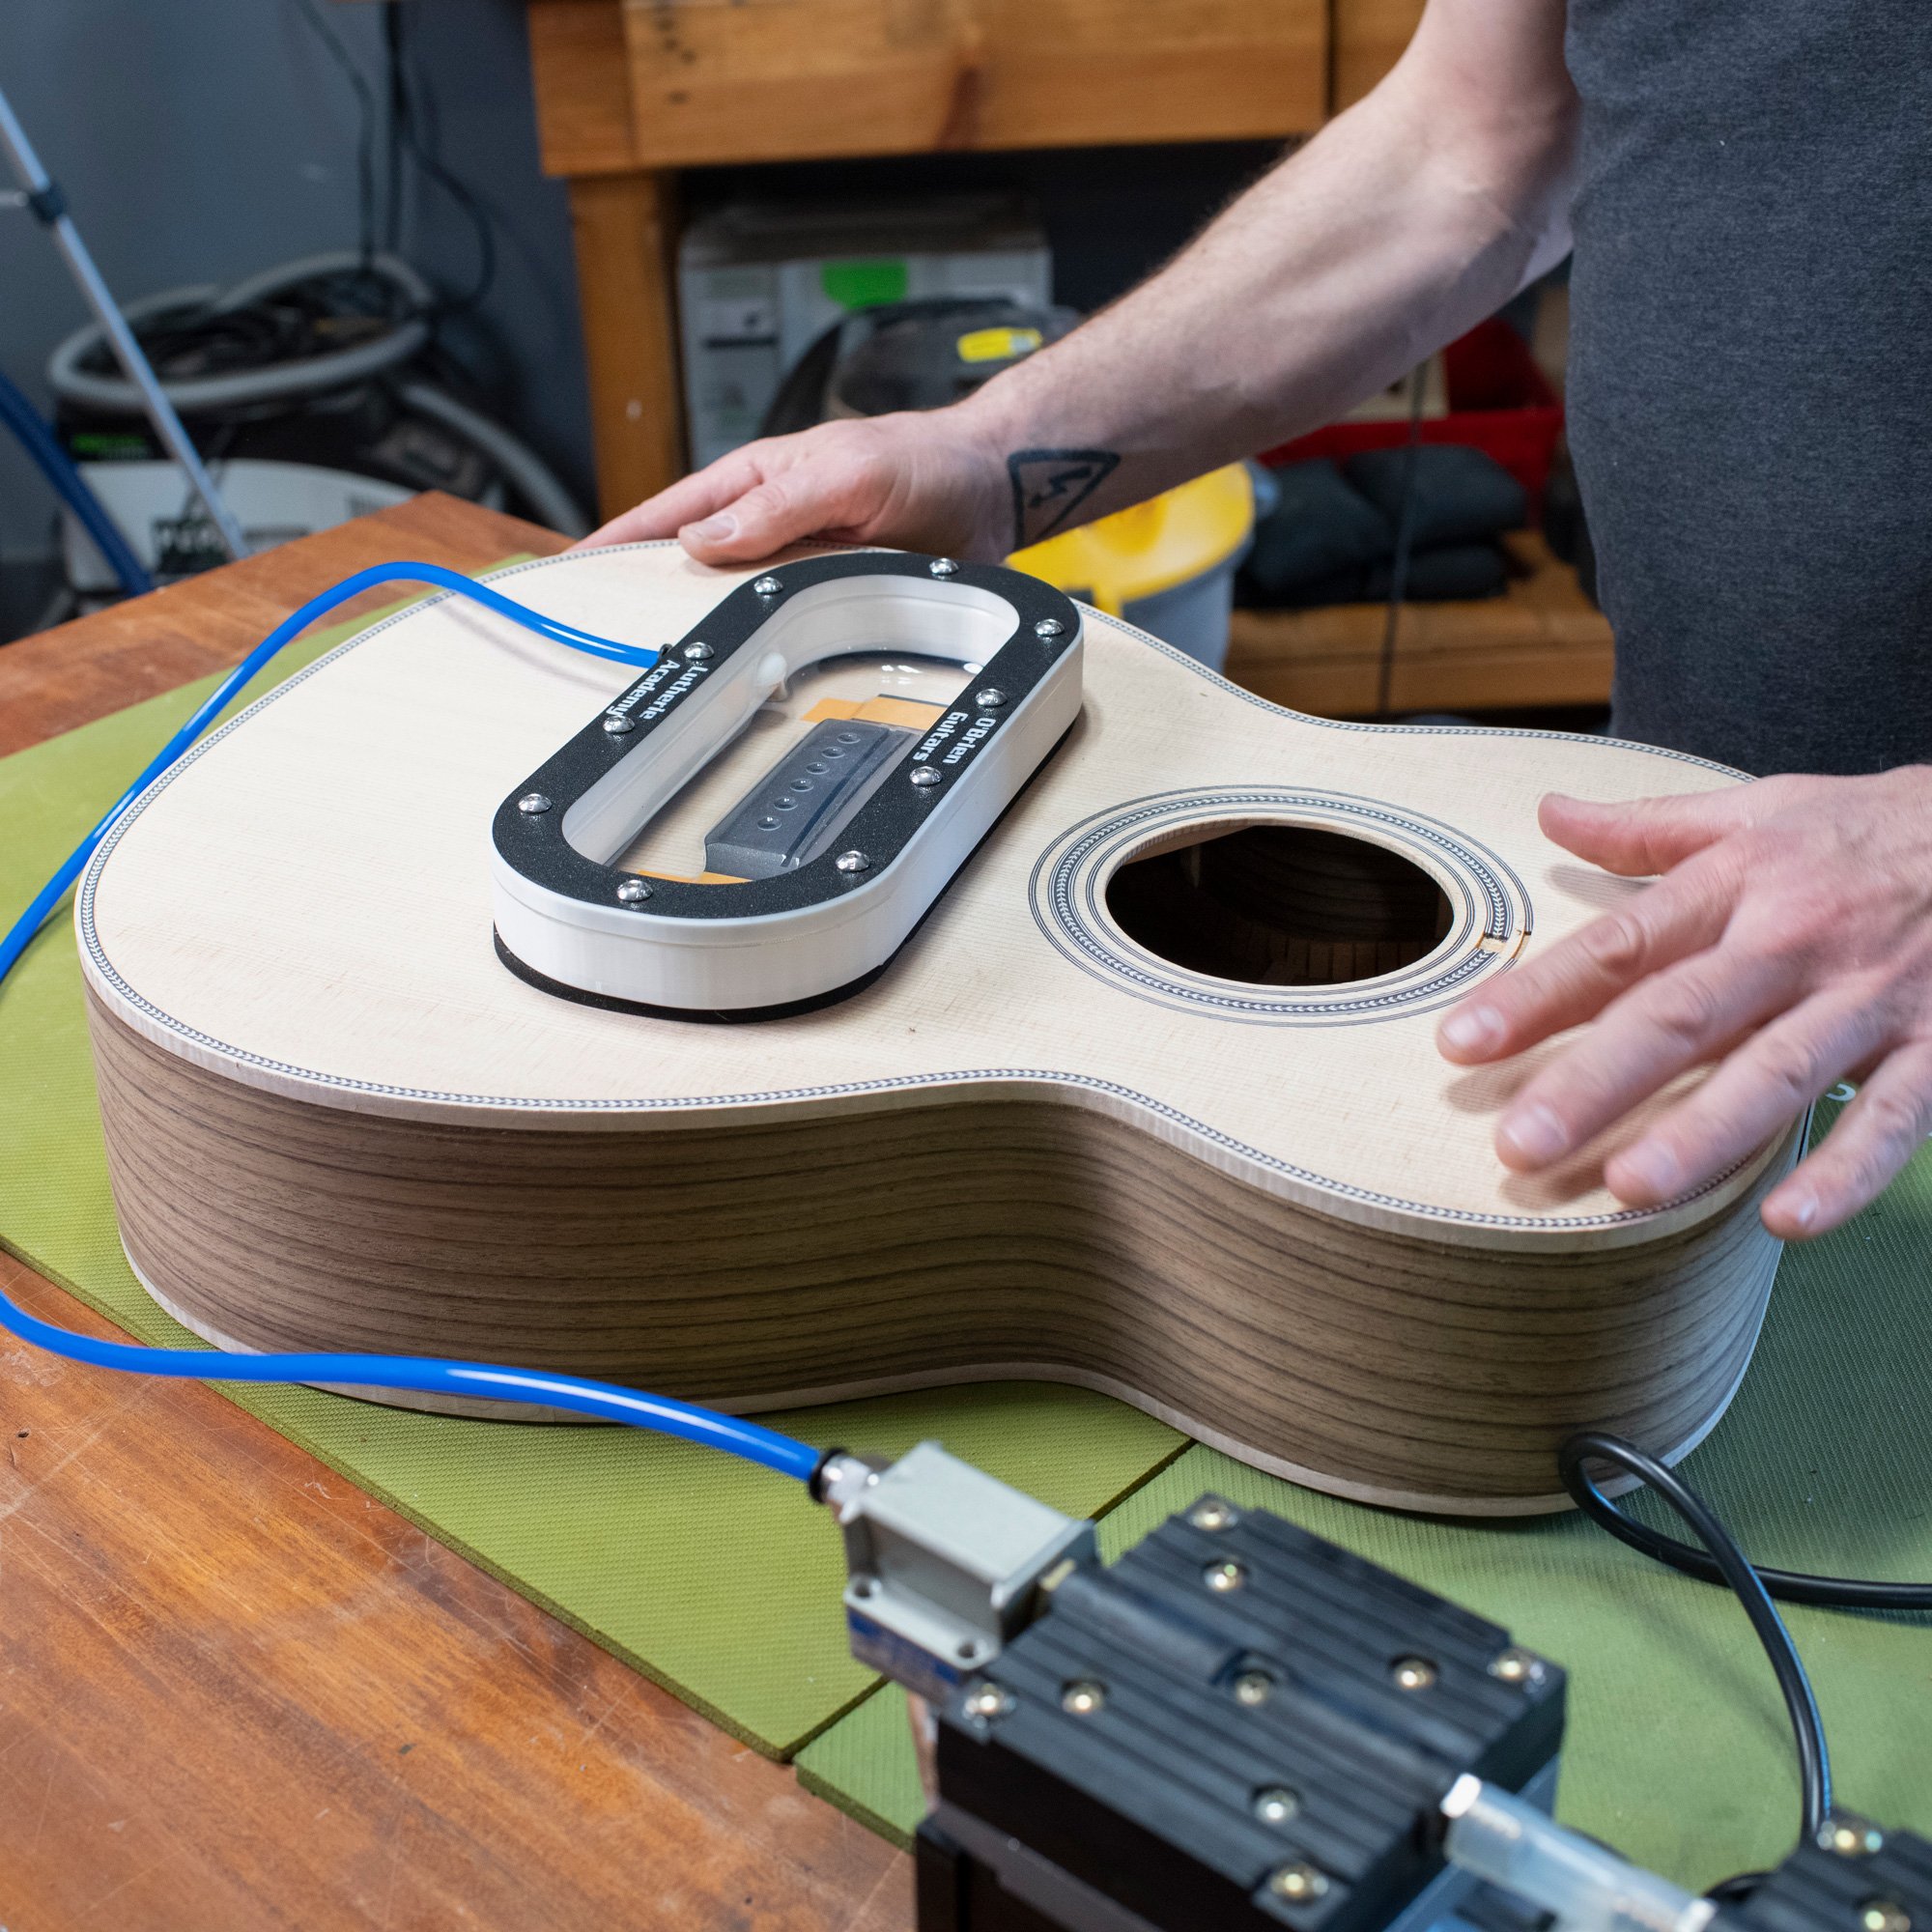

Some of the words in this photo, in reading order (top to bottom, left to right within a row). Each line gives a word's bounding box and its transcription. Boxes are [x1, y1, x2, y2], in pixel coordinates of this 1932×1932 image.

[606, 659, 680, 719] Academy
[639, 666, 708, 720] Lutherie
[912, 711, 969, 761] Guitars
